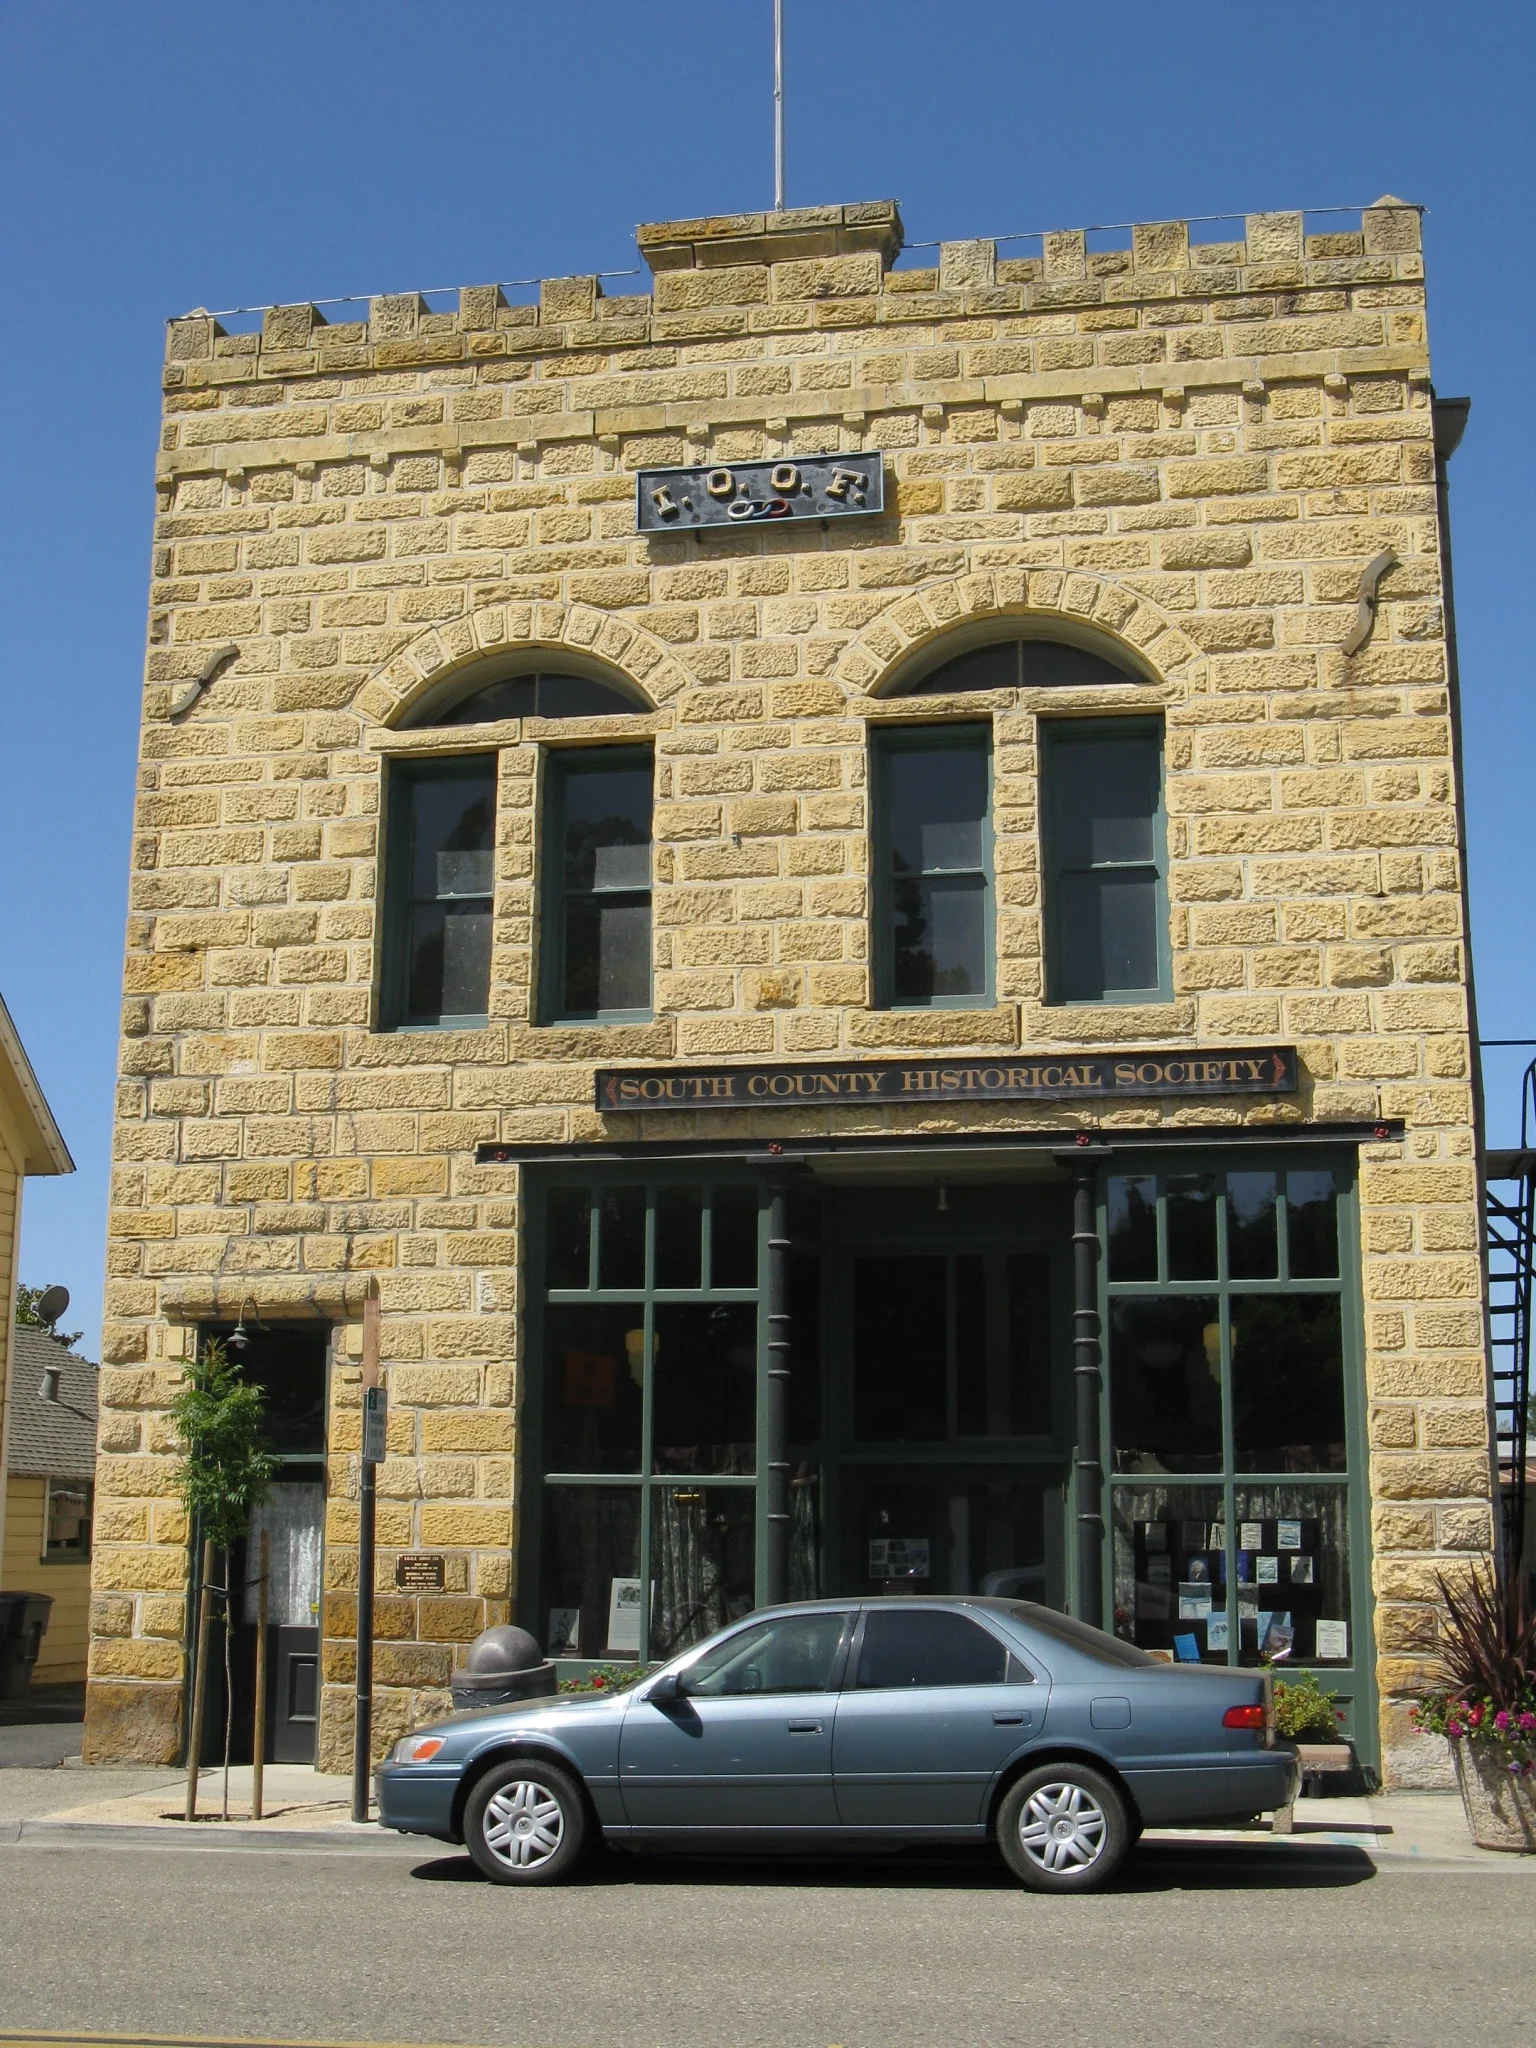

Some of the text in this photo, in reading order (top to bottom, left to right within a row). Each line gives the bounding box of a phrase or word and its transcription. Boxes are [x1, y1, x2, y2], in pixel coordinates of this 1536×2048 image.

[619, 1058, 1268, 1101] SOUTH COUNTY HISTORICAL SOCIETY
